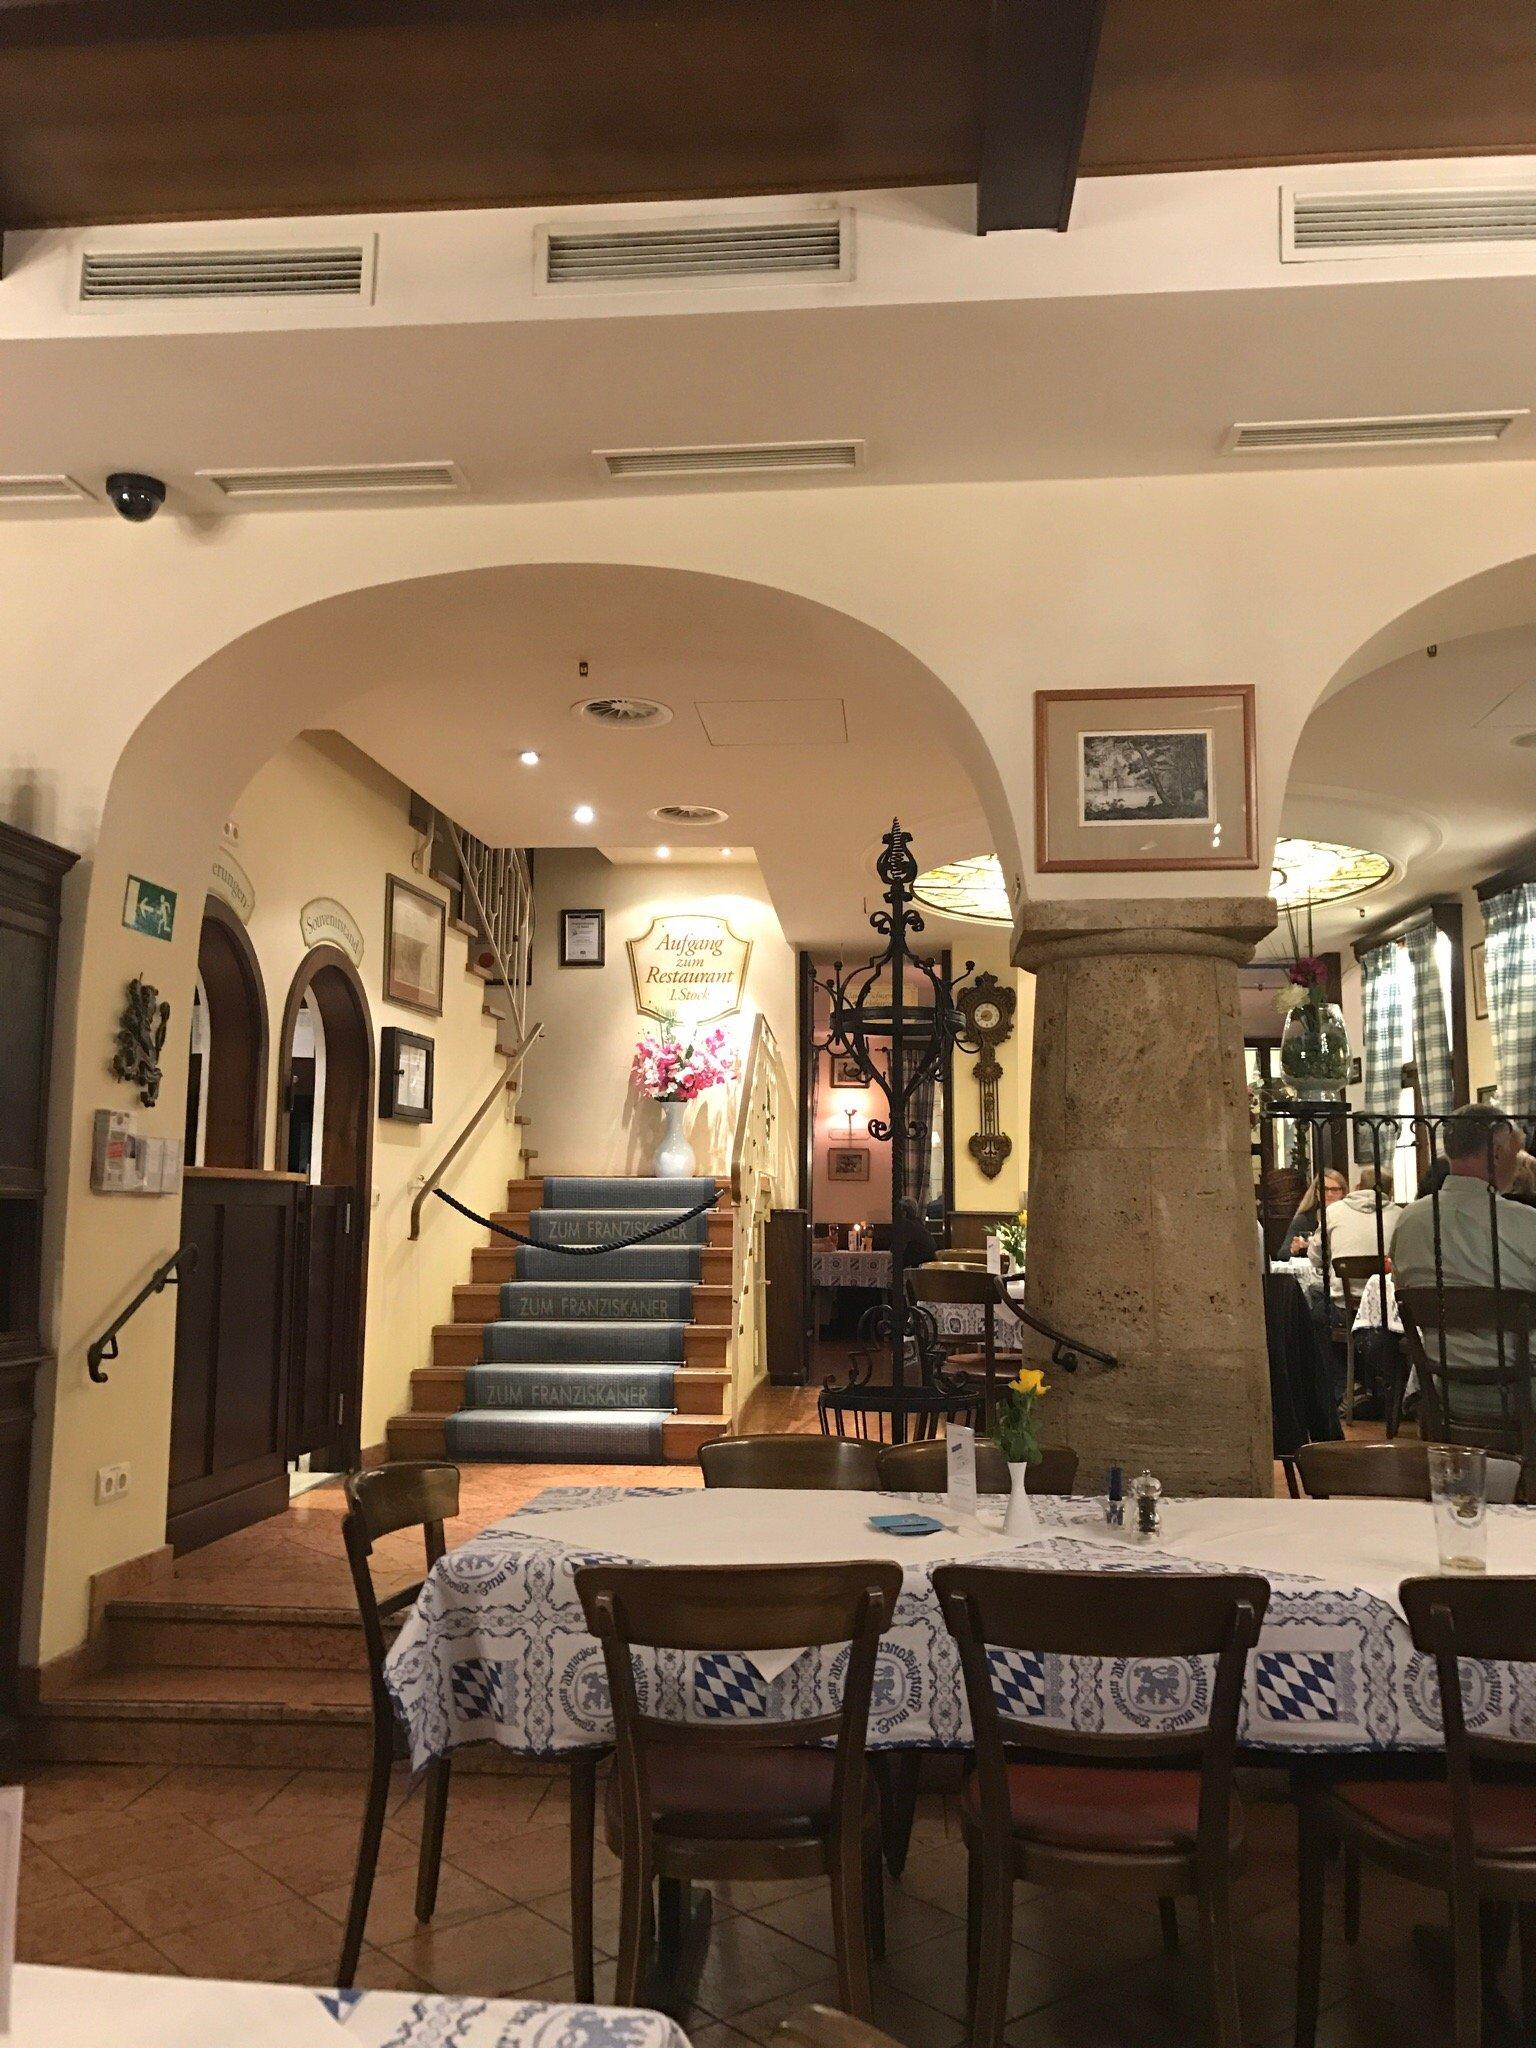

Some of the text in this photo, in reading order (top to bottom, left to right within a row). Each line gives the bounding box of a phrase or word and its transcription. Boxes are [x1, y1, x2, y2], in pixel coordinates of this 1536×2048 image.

[655, 933, 724, 956] Aufgang
[676, 958, 704, 968] zum
[645, 966, 735, 983] Restaurant
[549, 1221, 686, 1240] ZUM FRANZISKNER
[520, 1298, 668, 1318] ZUM FRANZISKANER
[486, 1385, 648, 1407] ZUM FRANZISKANER
